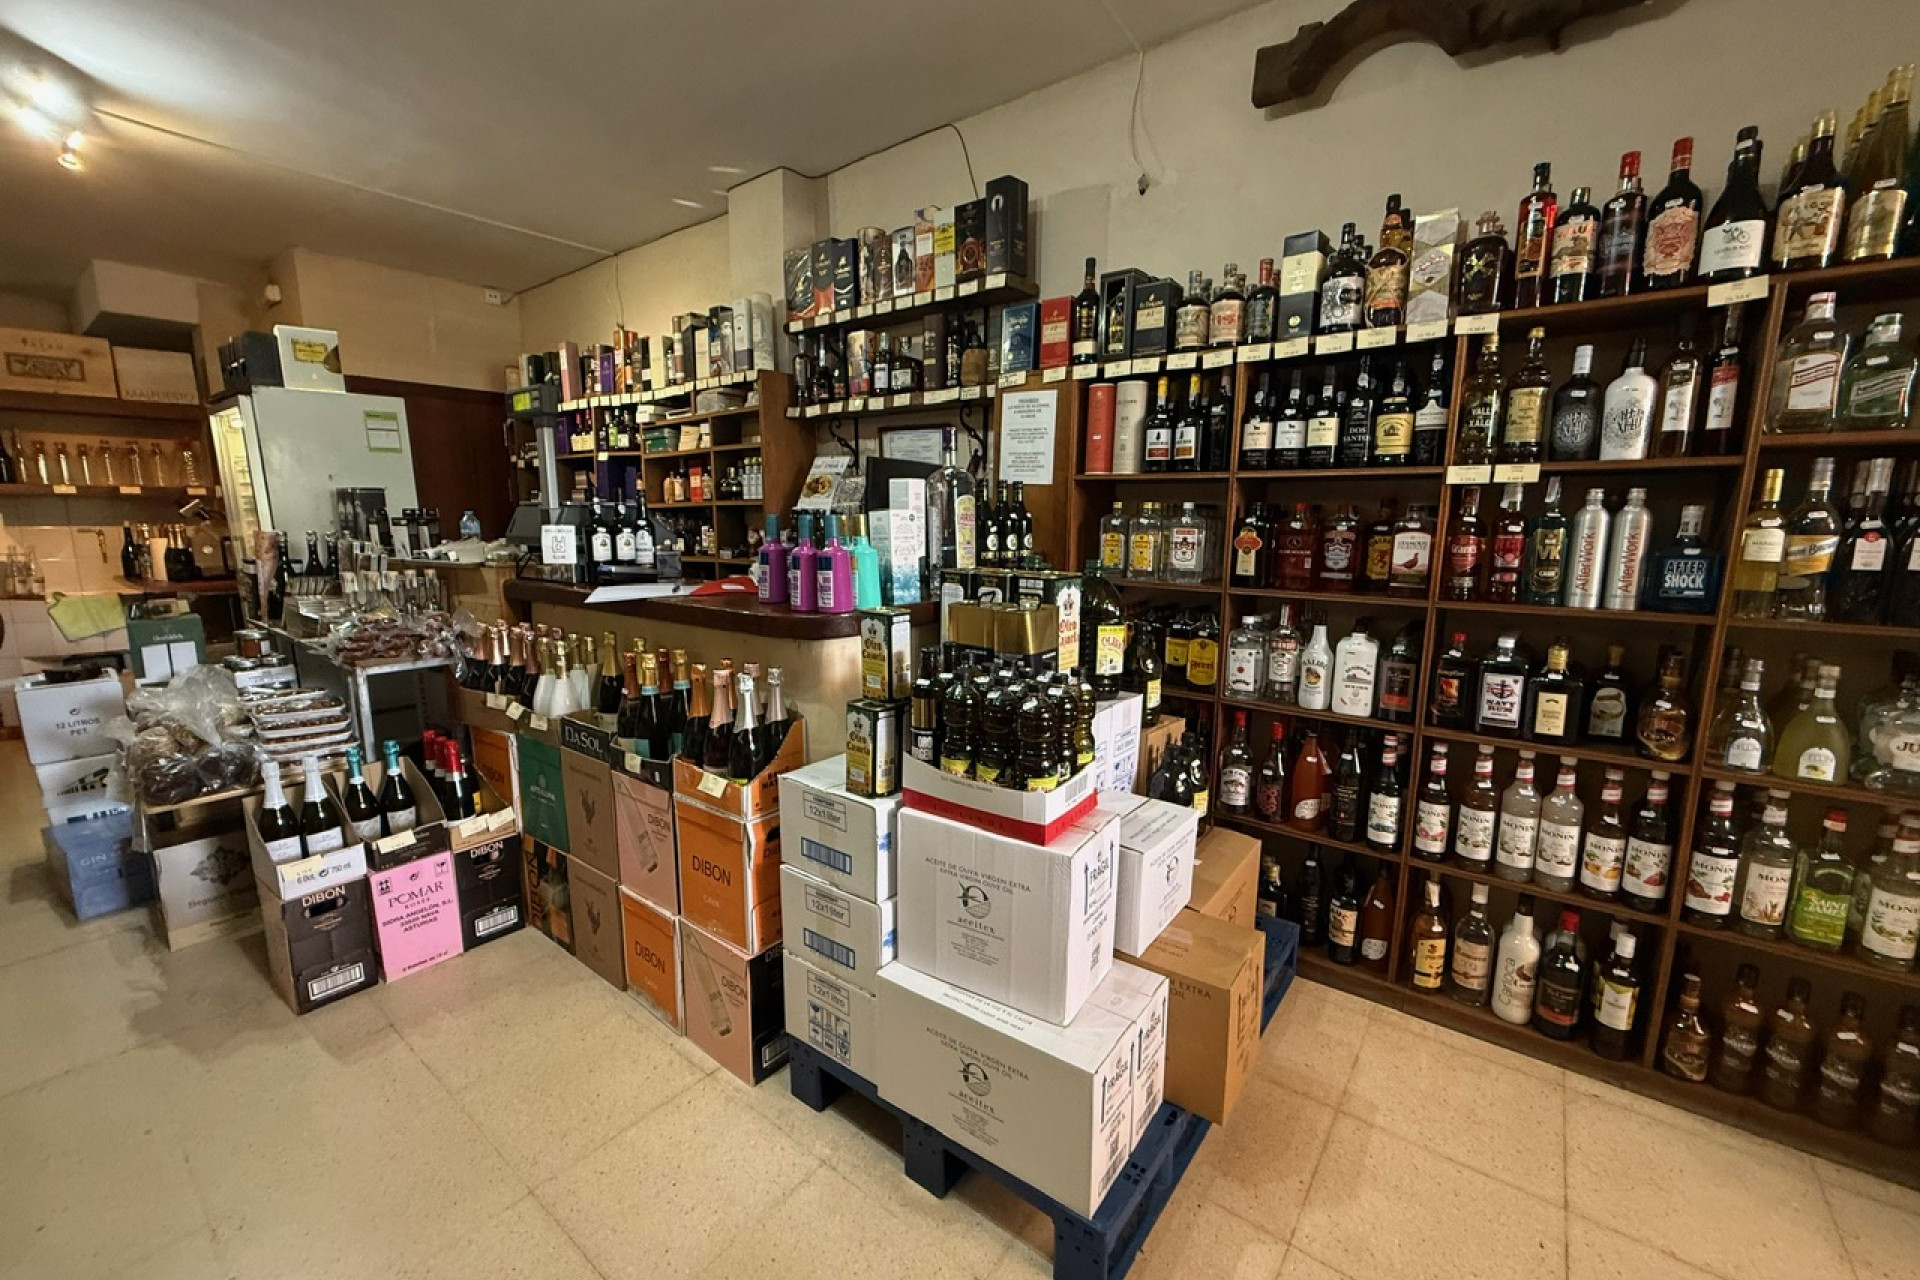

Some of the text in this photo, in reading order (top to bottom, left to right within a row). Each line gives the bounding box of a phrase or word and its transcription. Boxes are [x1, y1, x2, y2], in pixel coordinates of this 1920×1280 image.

[1575, 531, 1596, 593] AfterWork
[1618, 531, 1639, 593] AfterWork
[1664, 560, 1705, 576] AFTER
[1664, 576, 1704, 588] SHOCK
[1503, 820, 1536, 832] MONIN
[1541, 827, 1576, 840] MONIN
[470, 841, 504, 859] DIBON
[1632, 846, 1668, 859] MONIN
[692, 855, 732, 887] DIBON
[925, 856, 1032, 892] ACEITE DE OLIVA VIRGEN EXTRA
[1694, 860, 1735, 873] MONIN
[302, 885, 346, 908] DIBON
[388, 880, 444, 908] POMAR
[634, 939, 666, 974] DIBON
[721, 975, 748, 1000] DIBON
[1177, 980, 1212, 999] EXTRA
[1007, 1065, 1030, 1080] EXTRA
